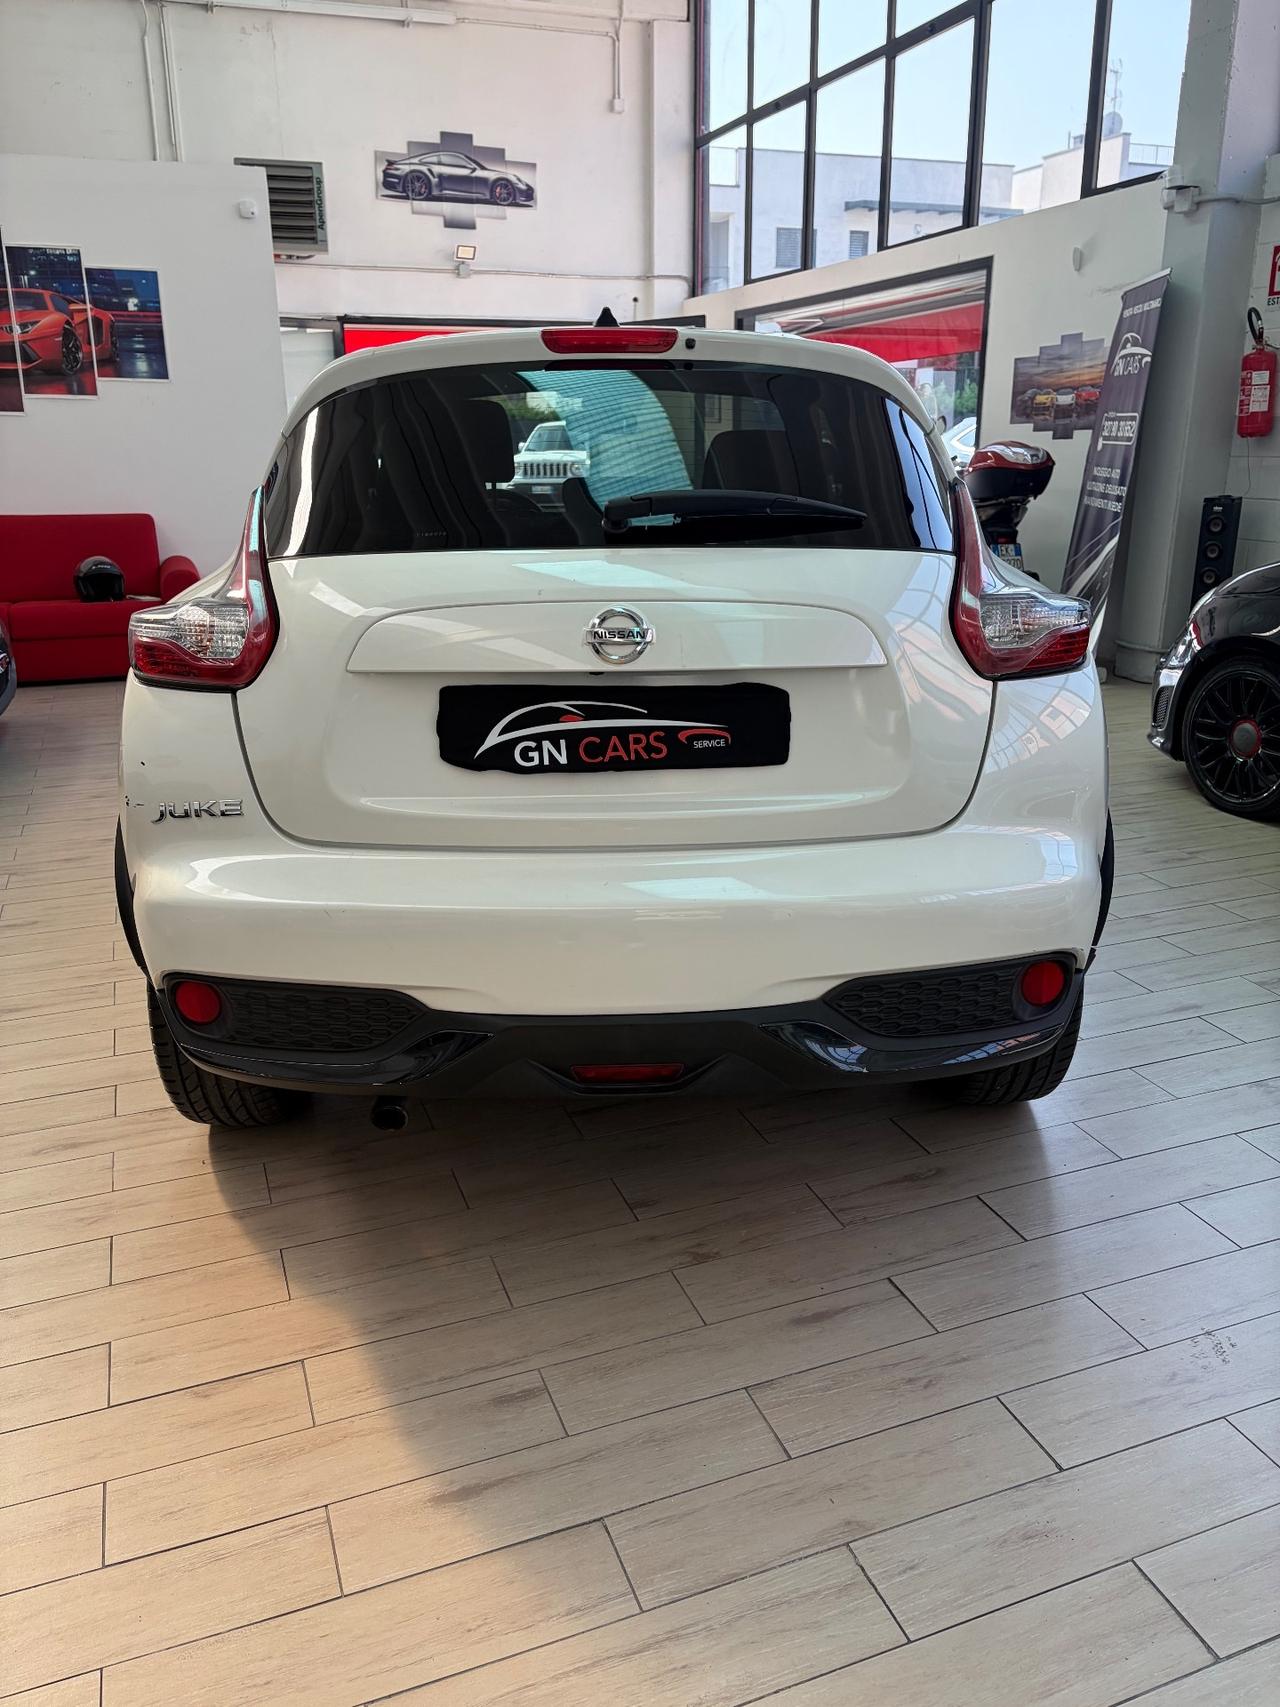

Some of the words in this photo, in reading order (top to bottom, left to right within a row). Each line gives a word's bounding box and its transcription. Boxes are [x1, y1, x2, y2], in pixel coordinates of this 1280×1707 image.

[315, 176, 326, 231] ApenGroup
[593, 630, 646, 640] NISSAN
[513, 739, 568, 767] GN
[578, 731, 668, 763] CARS
[693, 738, 726, 749] SERVICE
[151, 799, 244, 825] JUKE
